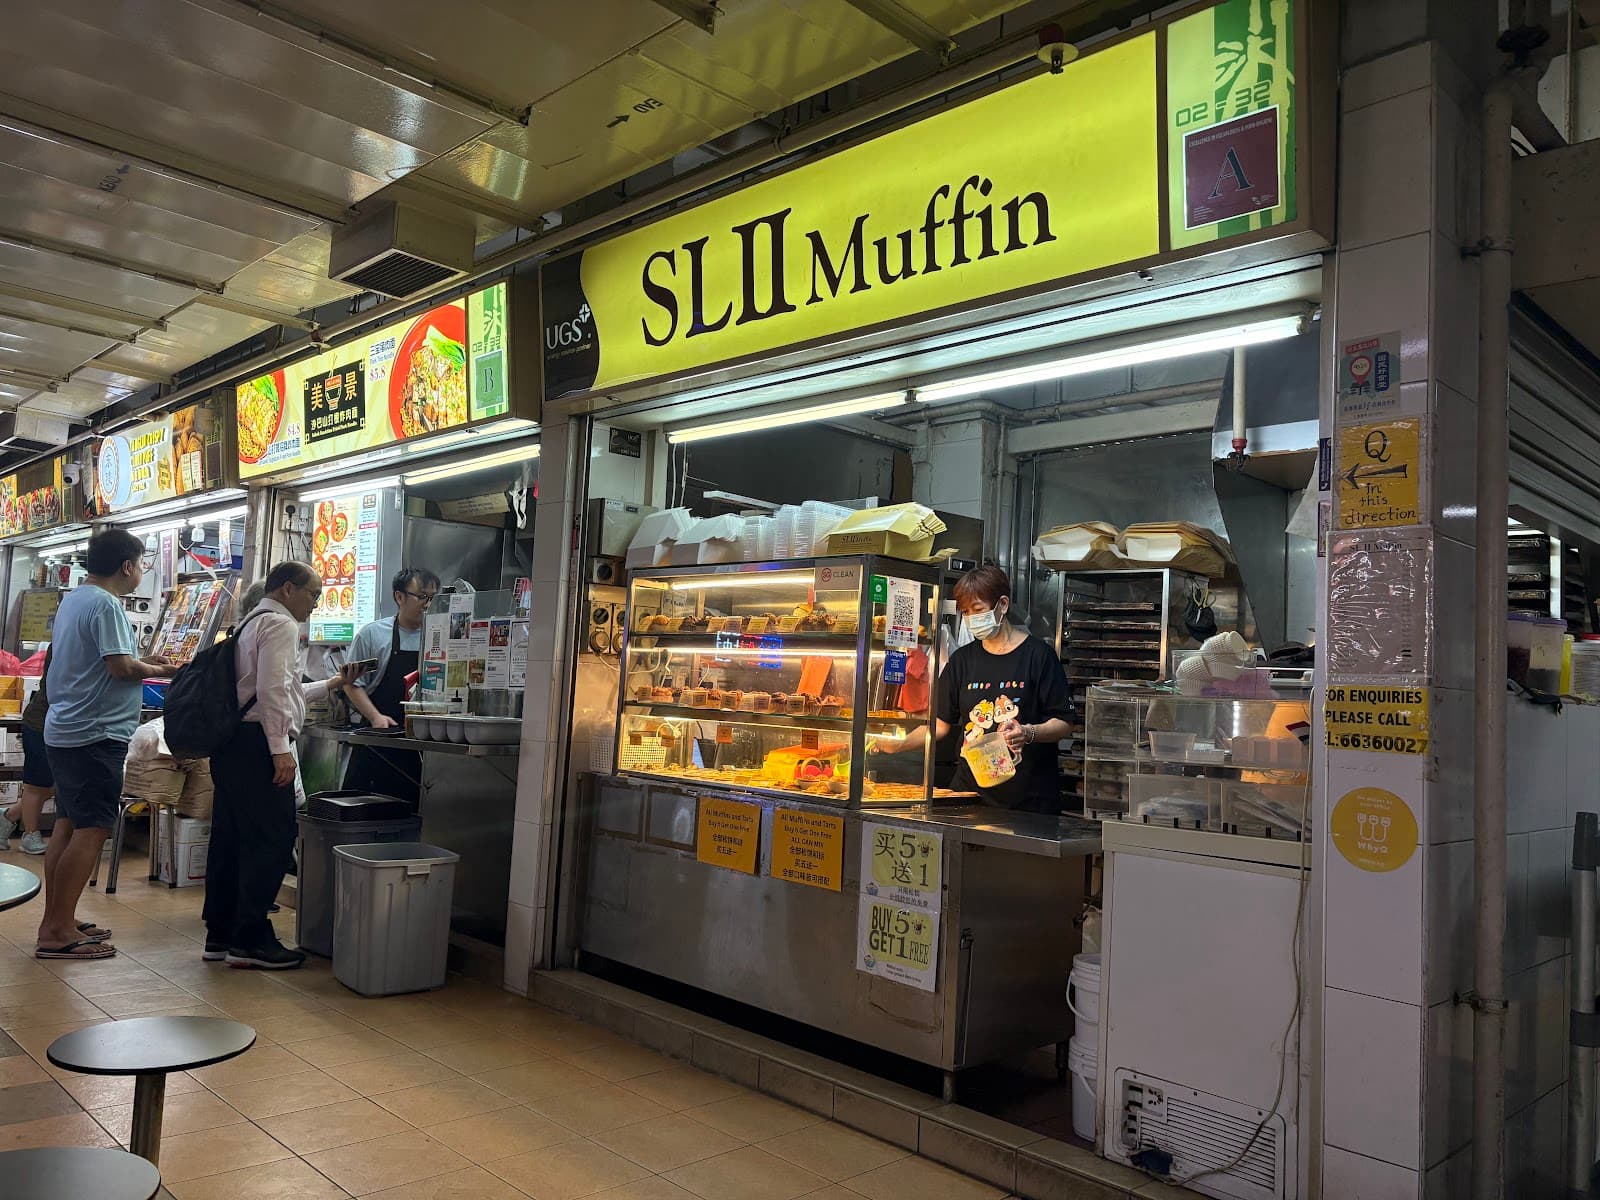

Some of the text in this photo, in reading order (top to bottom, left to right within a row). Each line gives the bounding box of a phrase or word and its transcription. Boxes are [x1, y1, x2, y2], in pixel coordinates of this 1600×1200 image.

[1175, 79, 1272, 127] 02-32
[1208, 146, 1255, 199] A
[805, 176, 1057, 306] Muffin
[546, 318, 582, 349] UGS
[369, 365, 386, 382] $5.8
[484, 367, 494, 393] B
[1365, 430, 1391, 462] Q
[1360, 495, 1388, 506] this
[1344, 506, 1416, 525] direction
[967, 680, 1025, 690] CHIP DALE
[1350, 689, 1422, 705] ENQUIRIES
[1378, 712, 1411, 726] CALL
[872, 905, 910, 934] BUY 5
[870, 930, 895, 955] GET
[896, 937, 909, 959] 1
